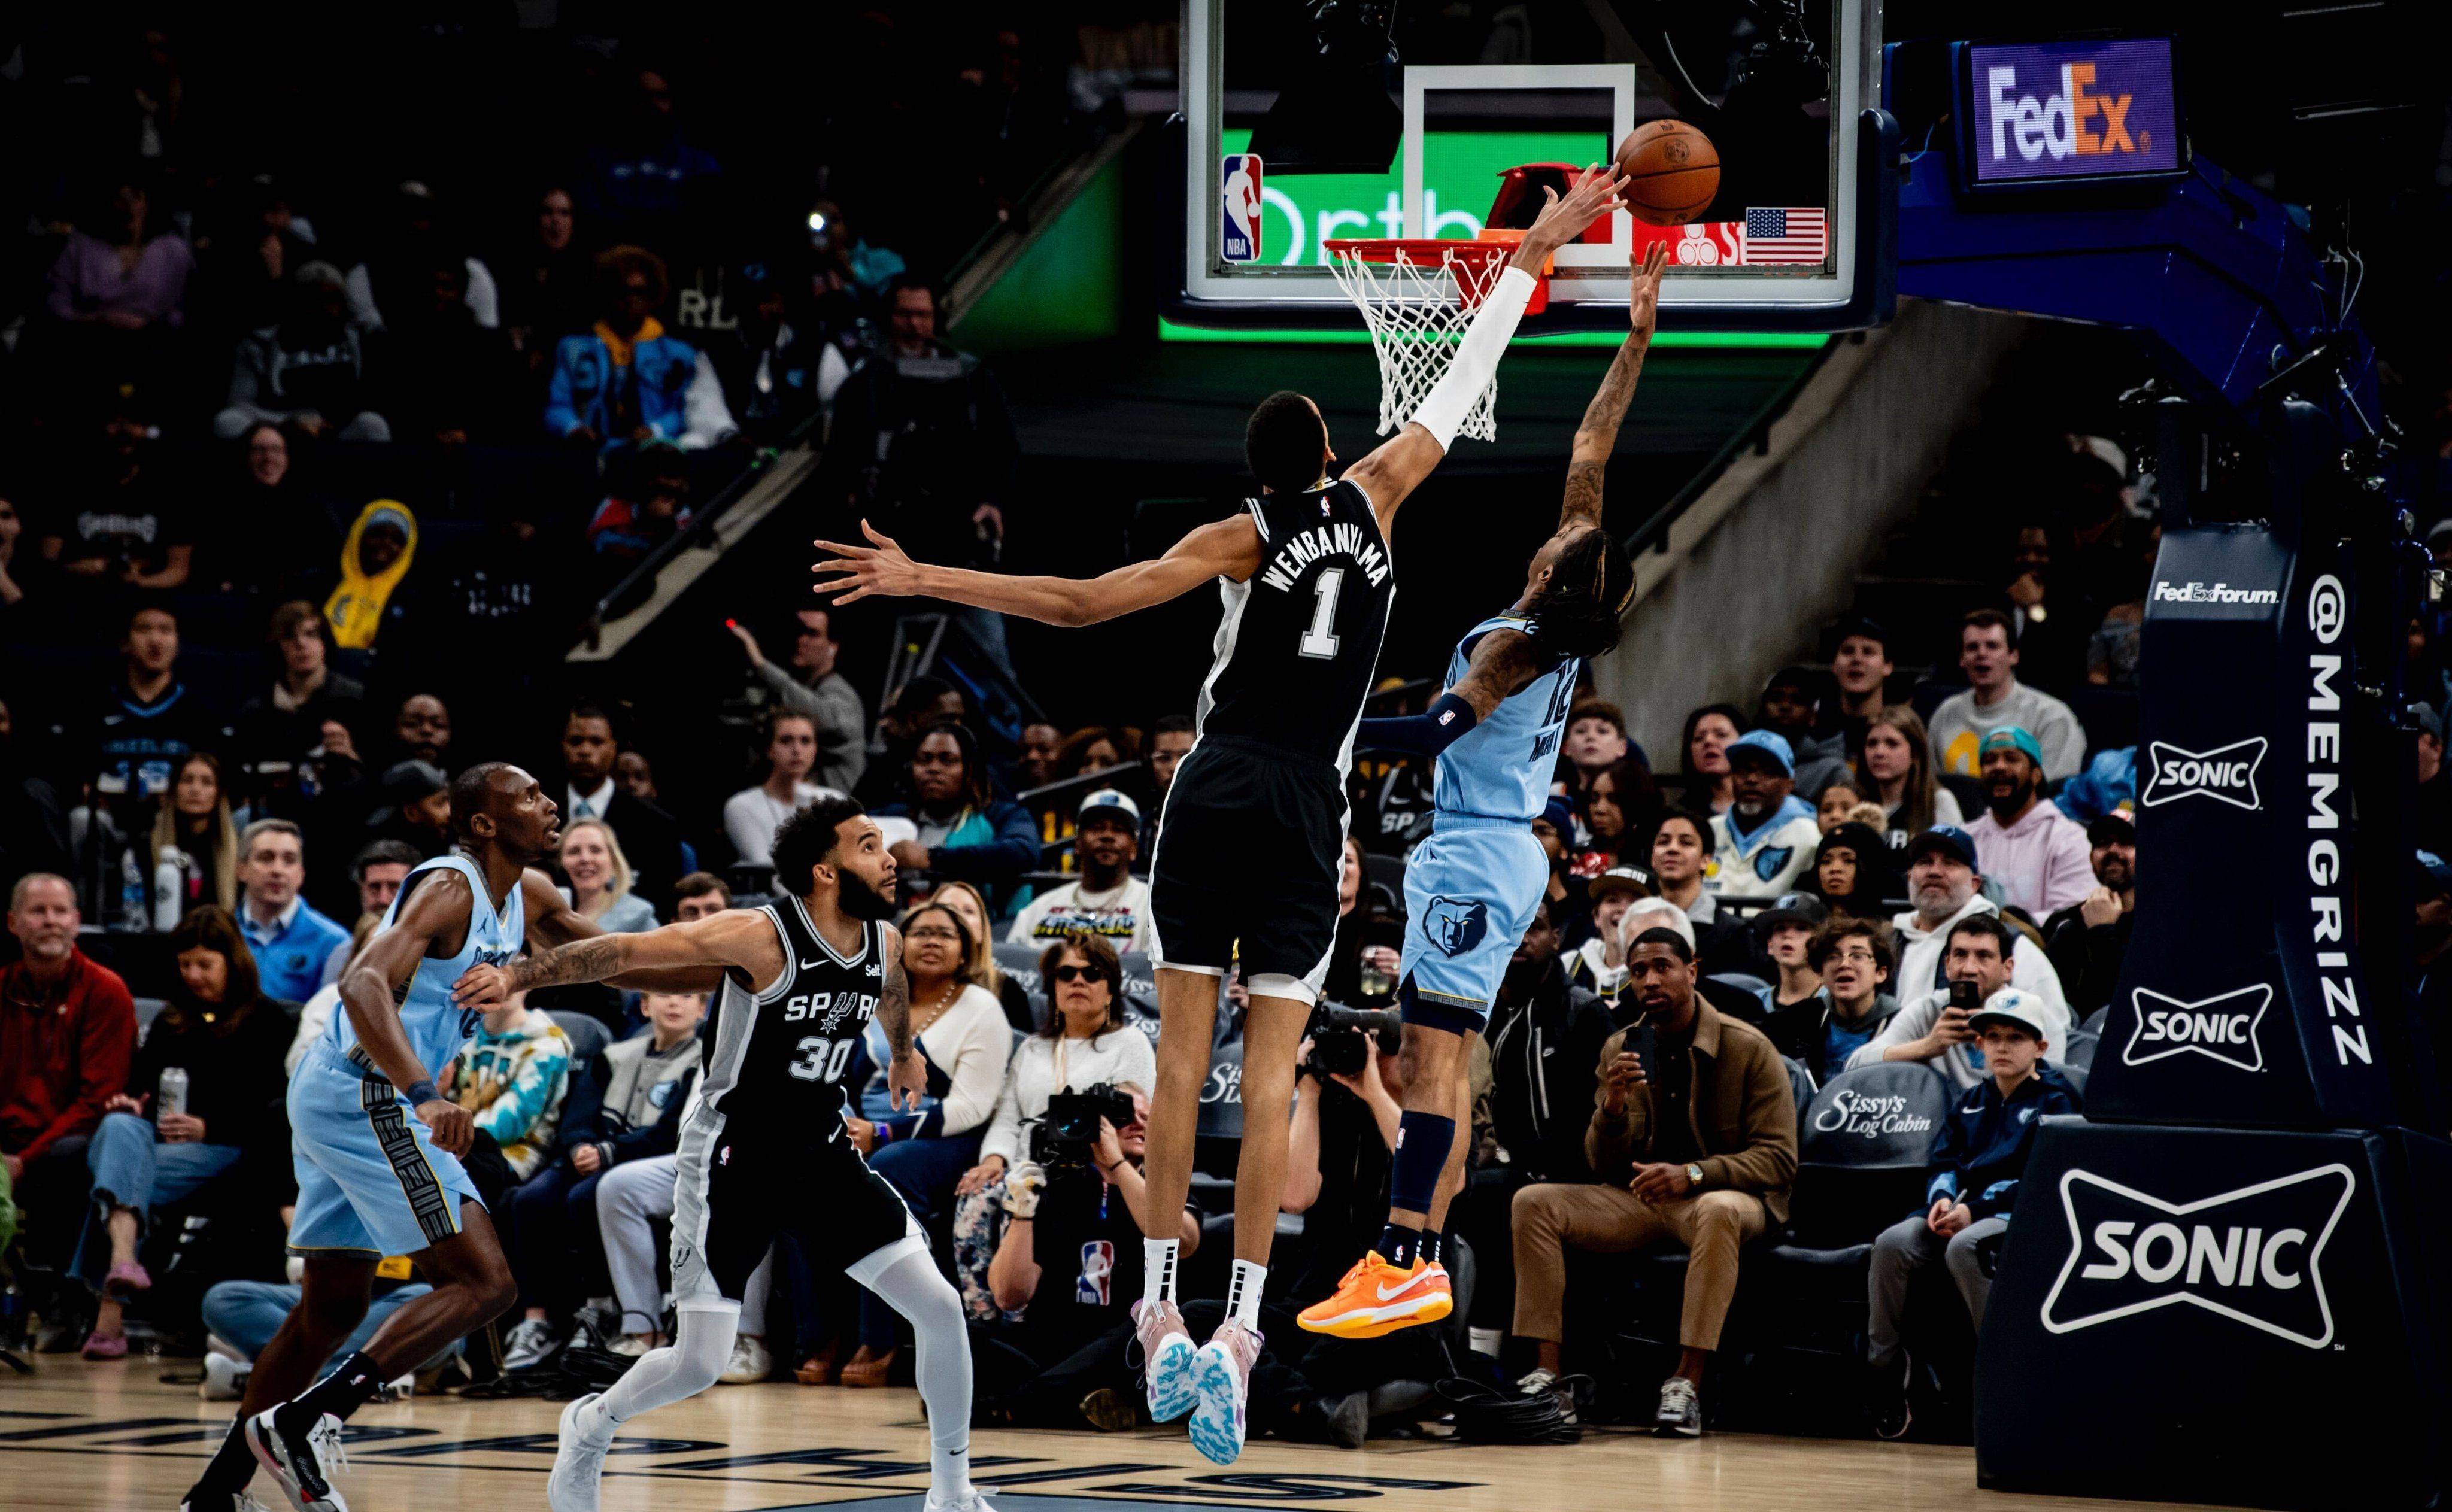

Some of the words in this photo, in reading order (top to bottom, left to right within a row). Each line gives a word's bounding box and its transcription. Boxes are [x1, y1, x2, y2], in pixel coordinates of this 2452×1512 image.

[1988, 62, 2136, 161] FedEx
[1227, 238, 1246, 256] NBA
[1260, 523, 1389, 593] WEMBANYAMA
[1298, 566, 1345, 660] 1
[2157, 760, 2250, 788] SONIC
[2307, 573, 2374, 1066] @MEMGRIZZ
[2141, 1011, 2251, 1045] SONIC
[788, 1035, 855, 1085] 30
[1815, 1090, 1907, 1131] Sissy's
[1845, 1114, 1881, 1138] Log
[1881, 1113, 1931, 1133] Cabin
[2080, 1219, 2308, 1291] SONIC
